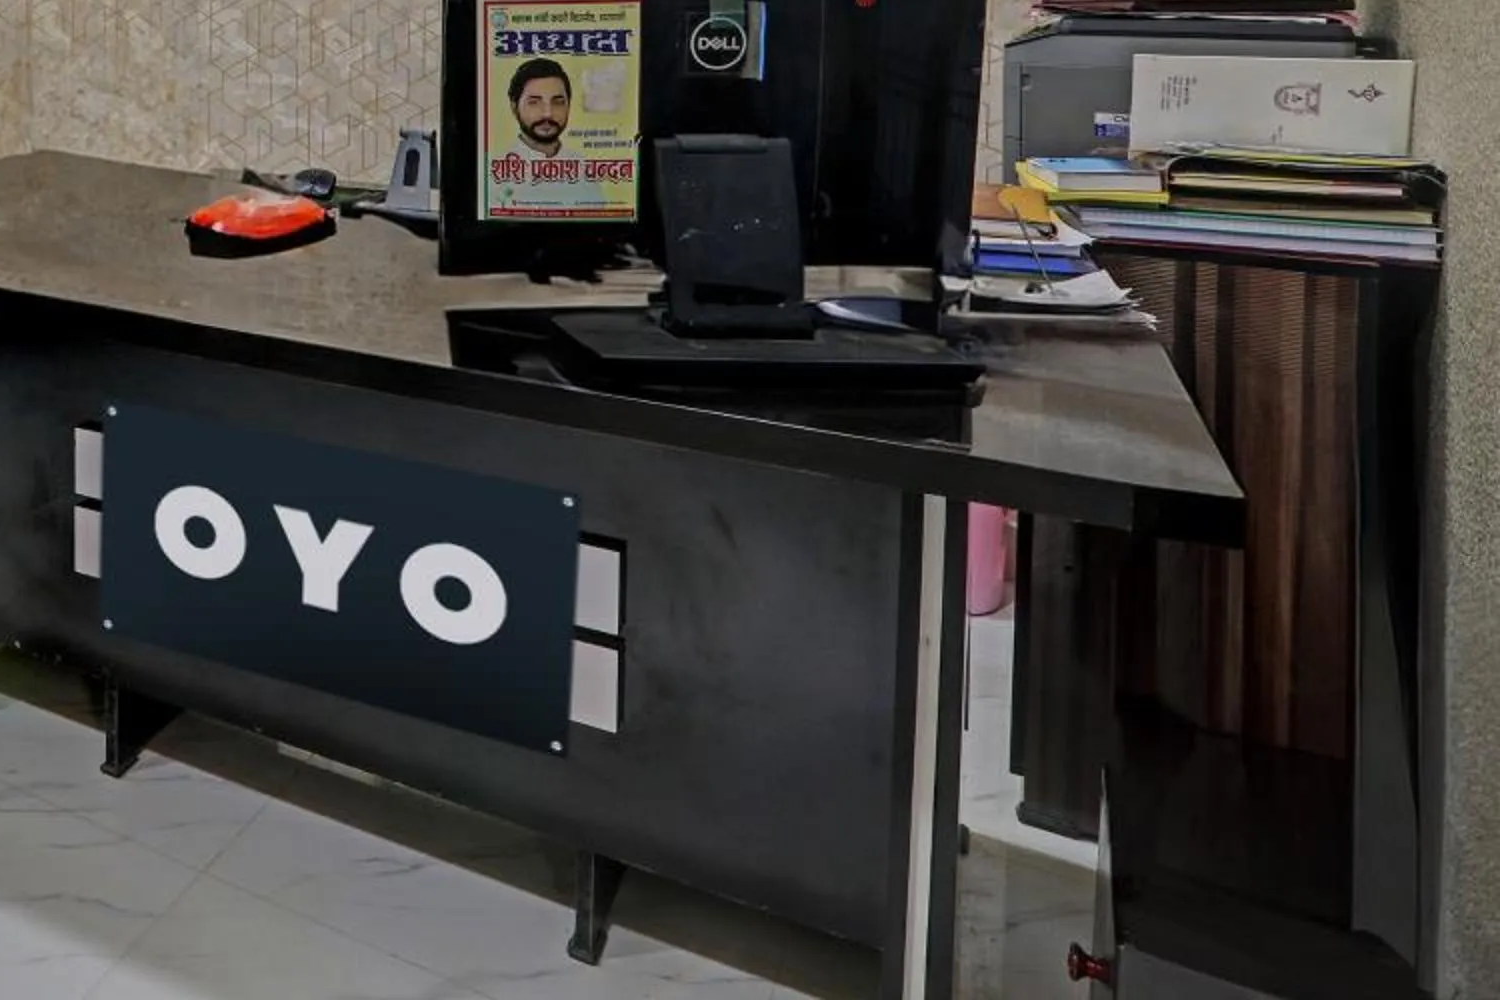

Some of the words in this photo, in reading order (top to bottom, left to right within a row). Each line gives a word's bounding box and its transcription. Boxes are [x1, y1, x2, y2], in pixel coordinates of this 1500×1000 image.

[699, 36, 741, 50] DELL
[491, 152, 526, 184] शशि
[531, 159, 580, 186] प्रकाश
[583, 159, 634, 185] चन्दन
[154, 485, 507, 645] OYO
